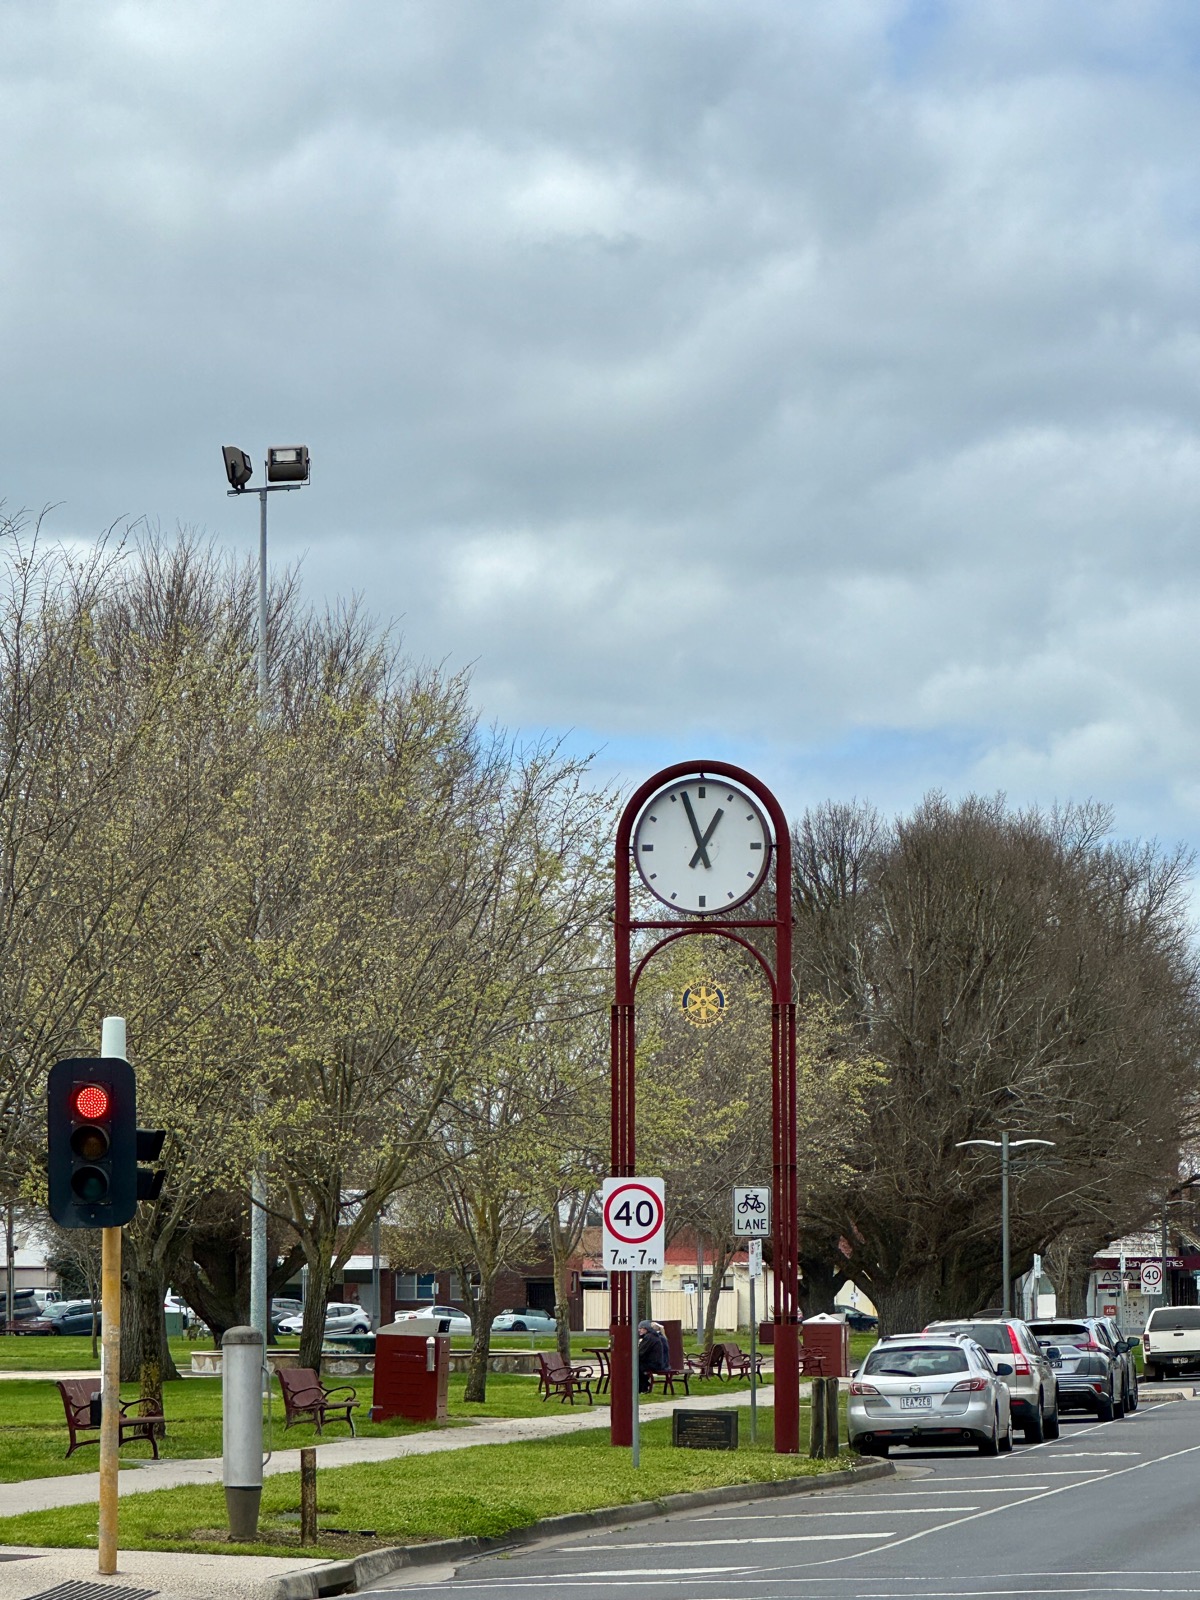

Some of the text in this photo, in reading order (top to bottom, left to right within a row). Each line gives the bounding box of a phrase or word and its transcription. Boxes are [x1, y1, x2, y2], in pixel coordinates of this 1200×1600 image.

[613, 1200, 654, 1227] 40
[737, 1218, 767, 1230] LANE
[1144, 1270, 1159, 1280] 40
